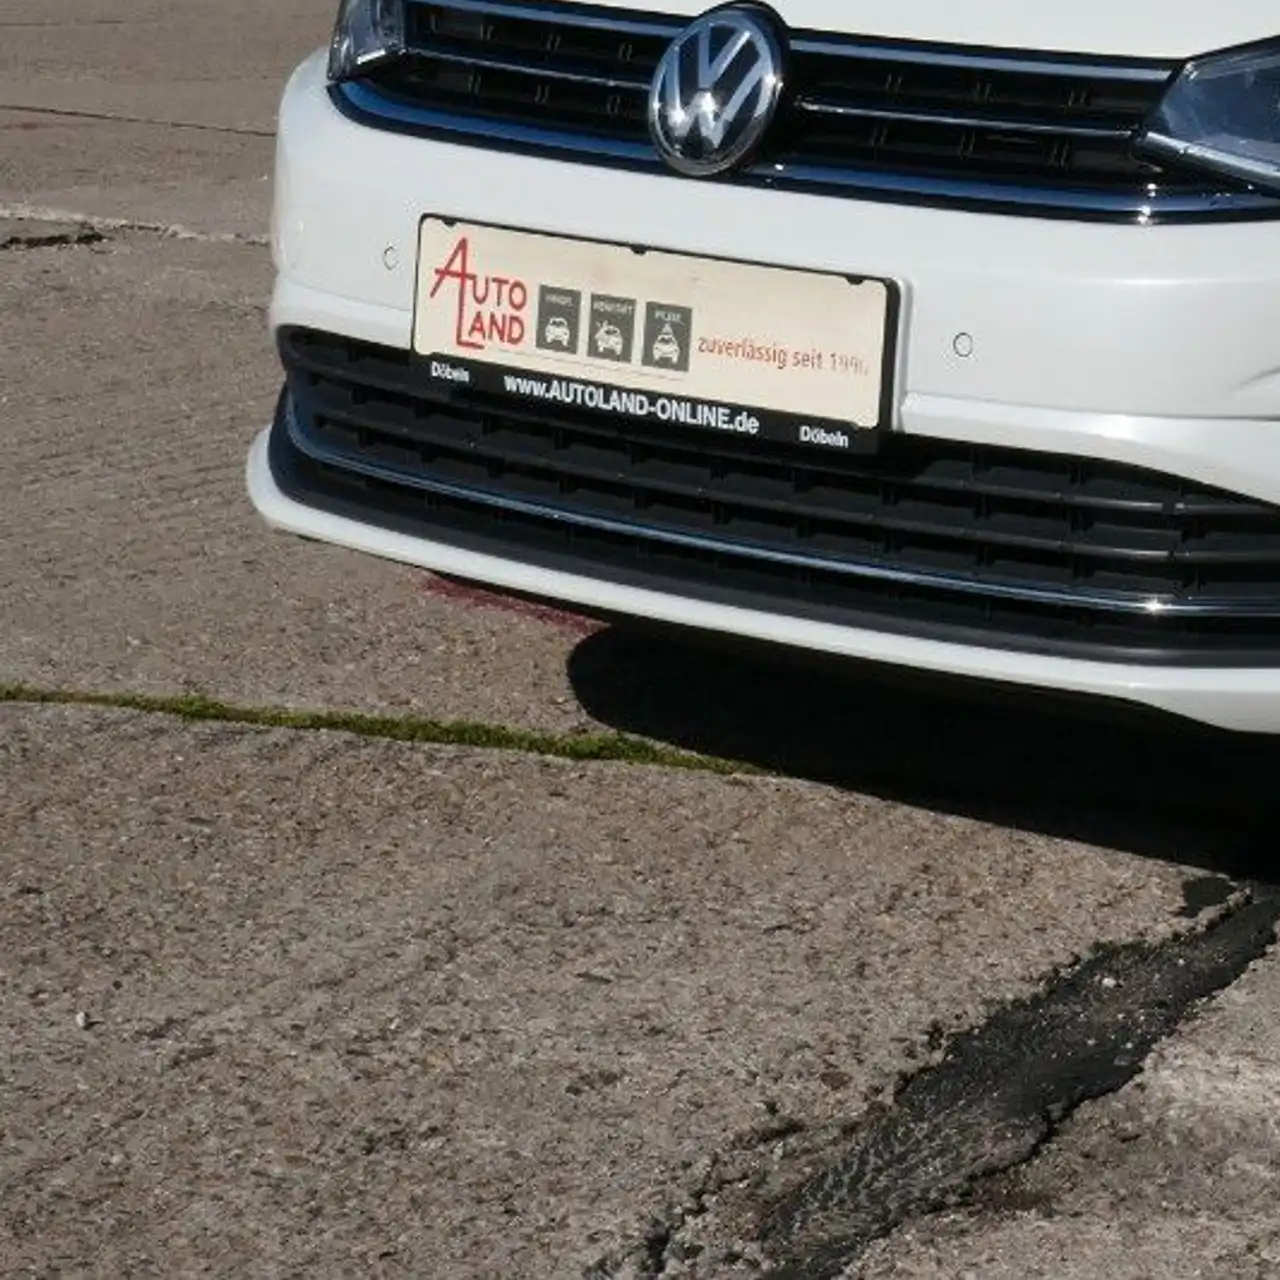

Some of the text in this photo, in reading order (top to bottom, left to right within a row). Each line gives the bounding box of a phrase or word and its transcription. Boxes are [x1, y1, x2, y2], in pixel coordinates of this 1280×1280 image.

[430, 237, 528, 311] AUTO
[457, 310, 525, 350] LAND
[698, 335, 787, 370] zuverlässig
[792, 348, 822, 370] seit
[503, 375, 760, 435] www.AUTOLAND-ONLINE.de
[799, 423, 850, 449] Döbeln
